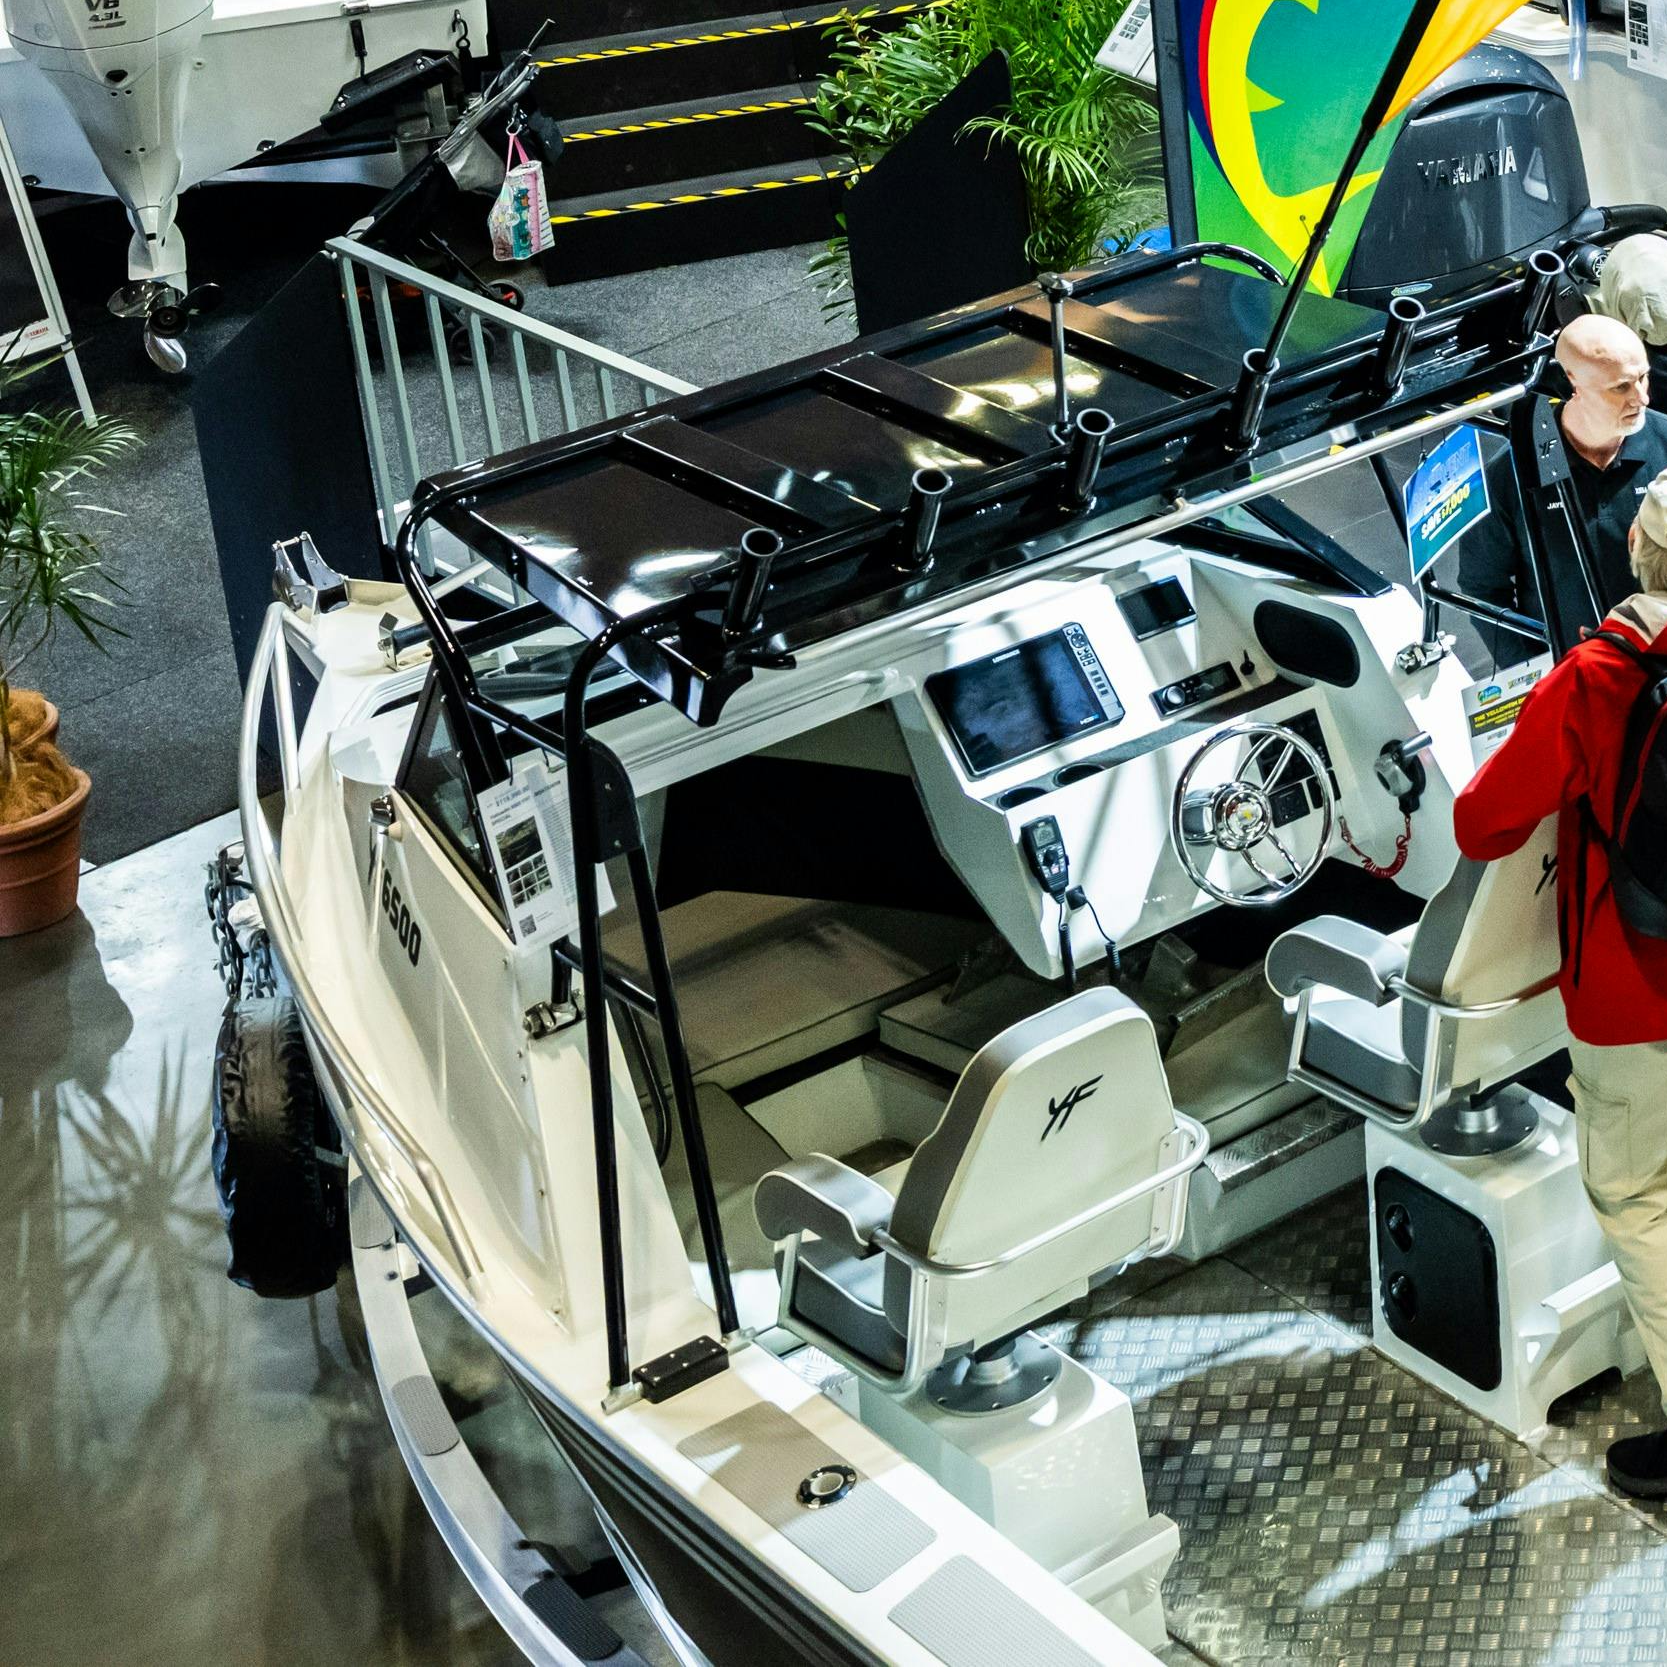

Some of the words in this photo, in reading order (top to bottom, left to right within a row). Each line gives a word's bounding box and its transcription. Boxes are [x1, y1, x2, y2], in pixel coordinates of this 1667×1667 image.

[1417, 146, 1518, 184] YAMAHA
[1420, 511, 1444, 540] SAVE
[381, 869, 422, 968] 6500
